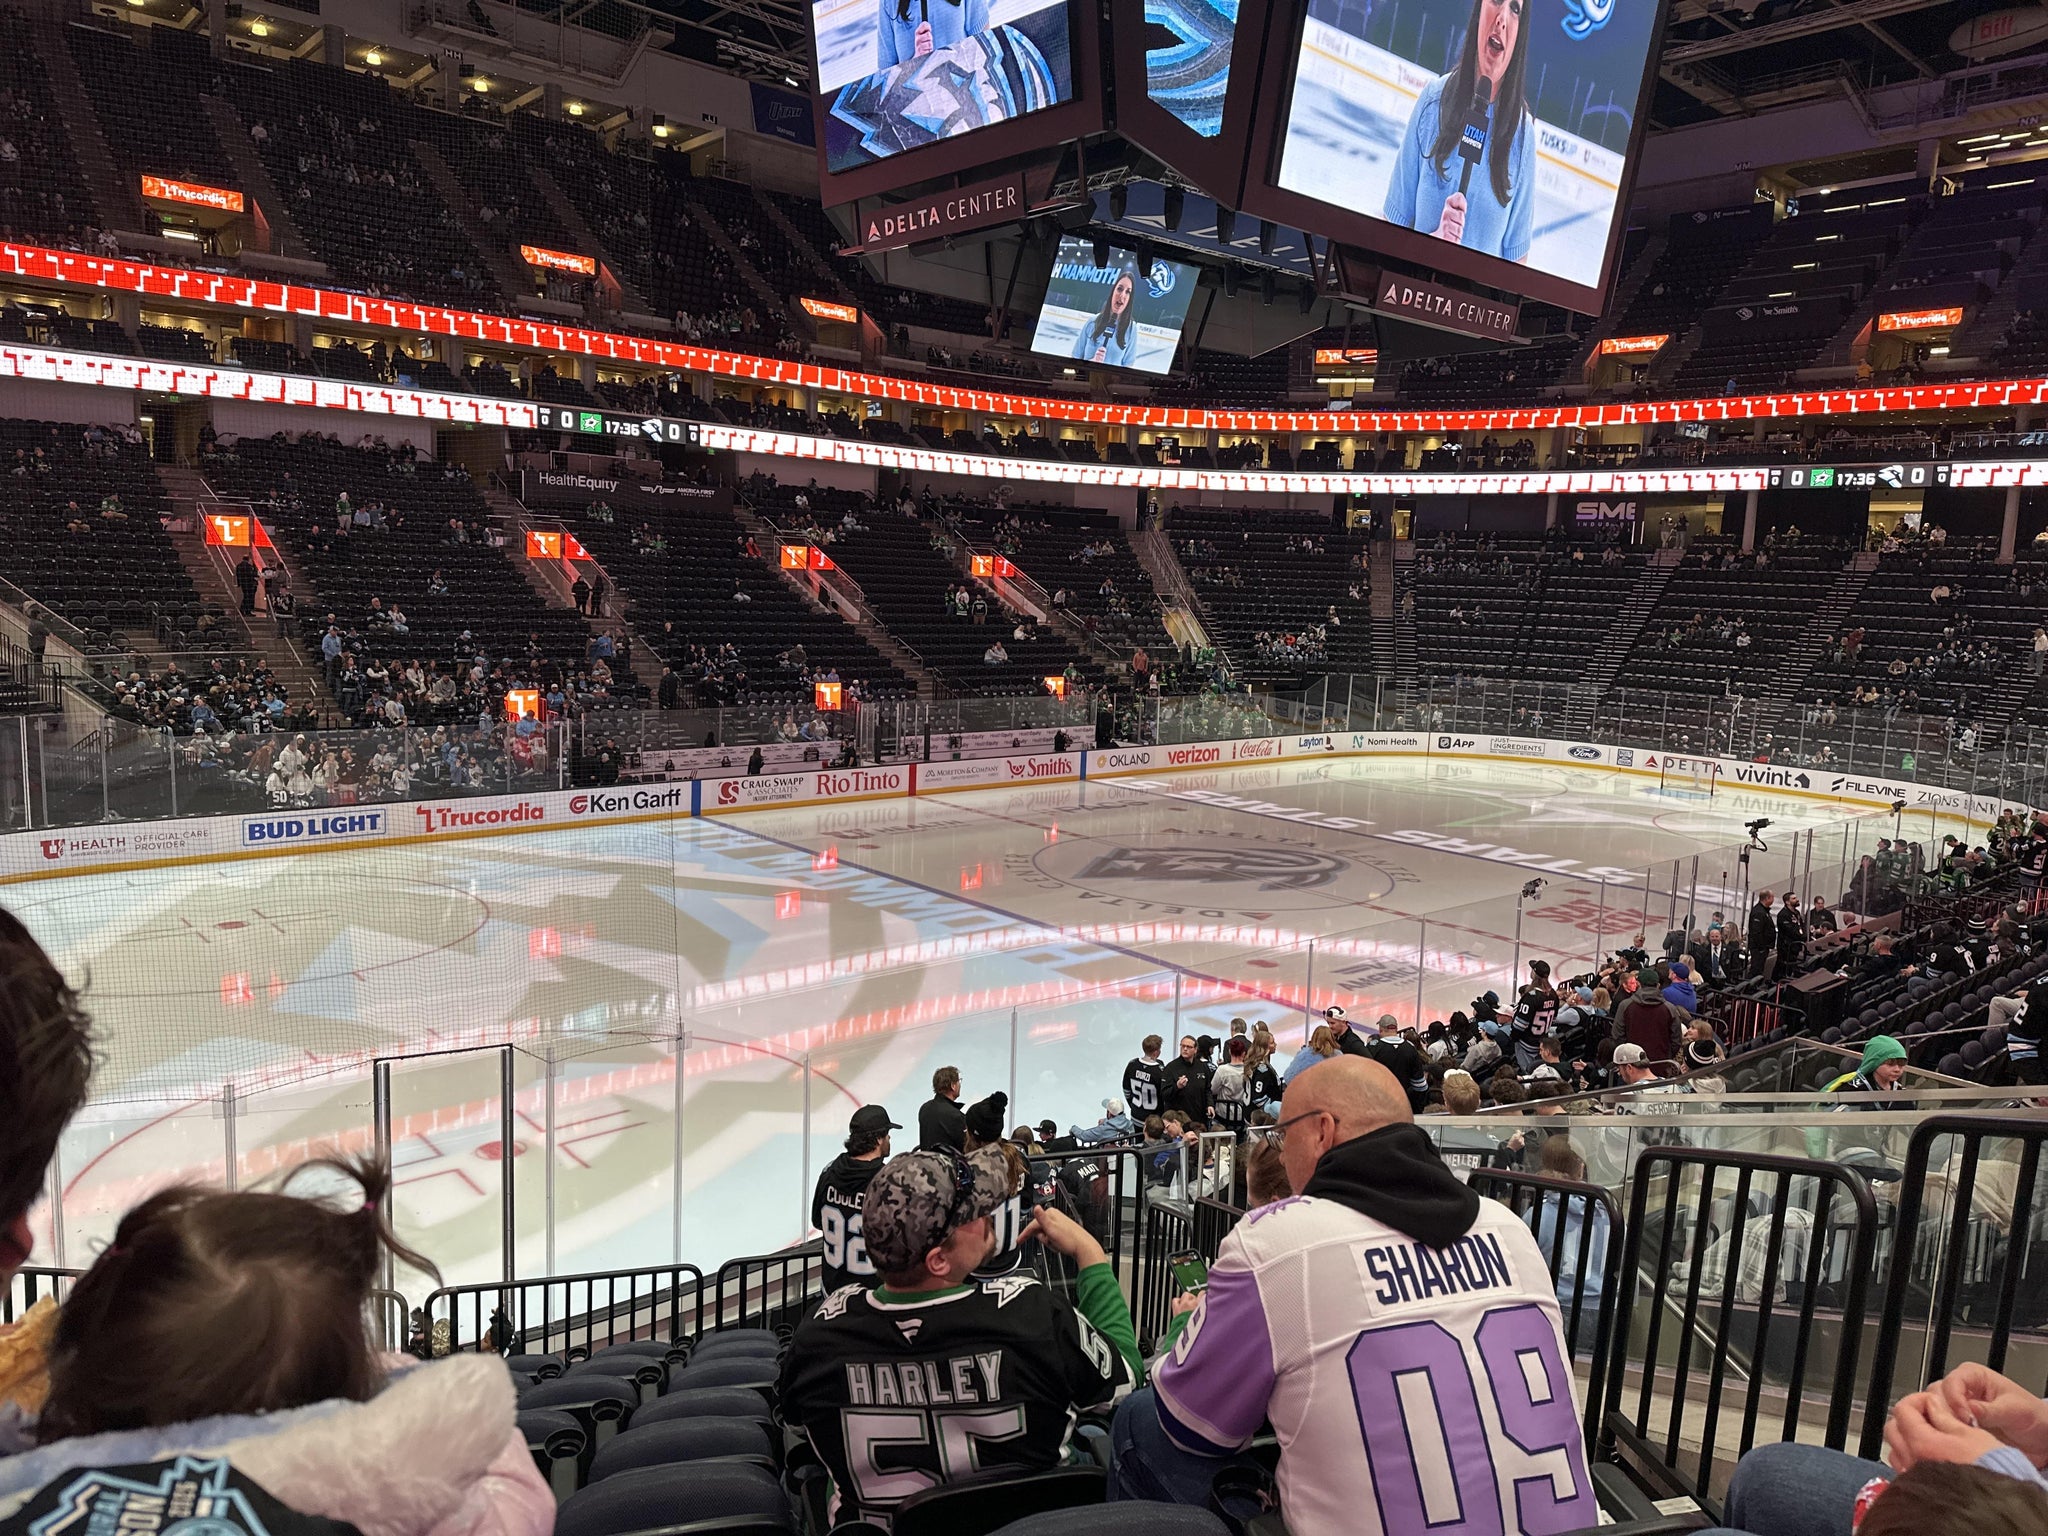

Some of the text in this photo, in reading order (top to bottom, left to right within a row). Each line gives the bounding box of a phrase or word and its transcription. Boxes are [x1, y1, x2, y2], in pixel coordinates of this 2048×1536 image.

[1980, 15, 2014, 39] bill
[1464, 124, 1486, 142] UTAH
[884, 187, 1016, 237] DELTA CENTER
[1060, 264, 1121, 285] MAMMOTH
[1402, 288, 1511, 331] DELTA CENTER
[560, 411, 573, 428] 0
[605, 420, 640, 436] 17:36
[668, 424, 680, 440] 0
[539, 472, 617, 492] HealthEquity
[1791, 470, 1803, 486] 0
[1837, 473, 1876, 486] 17:36
[1911, 467, 1925, 484] 0
[1299, 737, 1323, 749] Layton
[1367, 738, 1417, 746] Nomi Health
[1493, 743, 1542, 752] INGREDIENTS
[1109, 752, 1149, 767] OKLAND
[1168, 745, 1219, 764] verizon
[1574, 747, 1595, 758] Ford
[1028, 757, 1072, 777] Smith's
[1665, 758, 1724, 775] DELTA
[741, 777, 804, 790] CRAIG SWAPP
[1736, 765, 1793, 787] vivint
[272, 791, 288, 803] 50
[754, 786, 798, 796] ASSOCIATES
[1846, 782, 1906, 798] FILEVINE
[591, 788, 681, 812] Ken Garff
[1917, 791, 1959, 808] ZIONS
[428, 803, 543, 829] Trucordia
[134, 829, 208, 843] OFFICIAL CARE
[248, 814, 381, 841] BUD LIGHT
[71, 837, 125, 850] HEALTH
[135, 840, 186, 851] PROVIDER
[1531, 1010, 1557, 1036] 50
[1130, 1078, 1158, 1111] 50
[1255, 1081, 1263, 1093] 9
[821, 1204, 877, 1275] 92
[1364, 1232, 1512, 1306] SHARON
[846, 1350, 1003, 1406] HARLEY
[1345, 1303, 1600, 1536] 09
